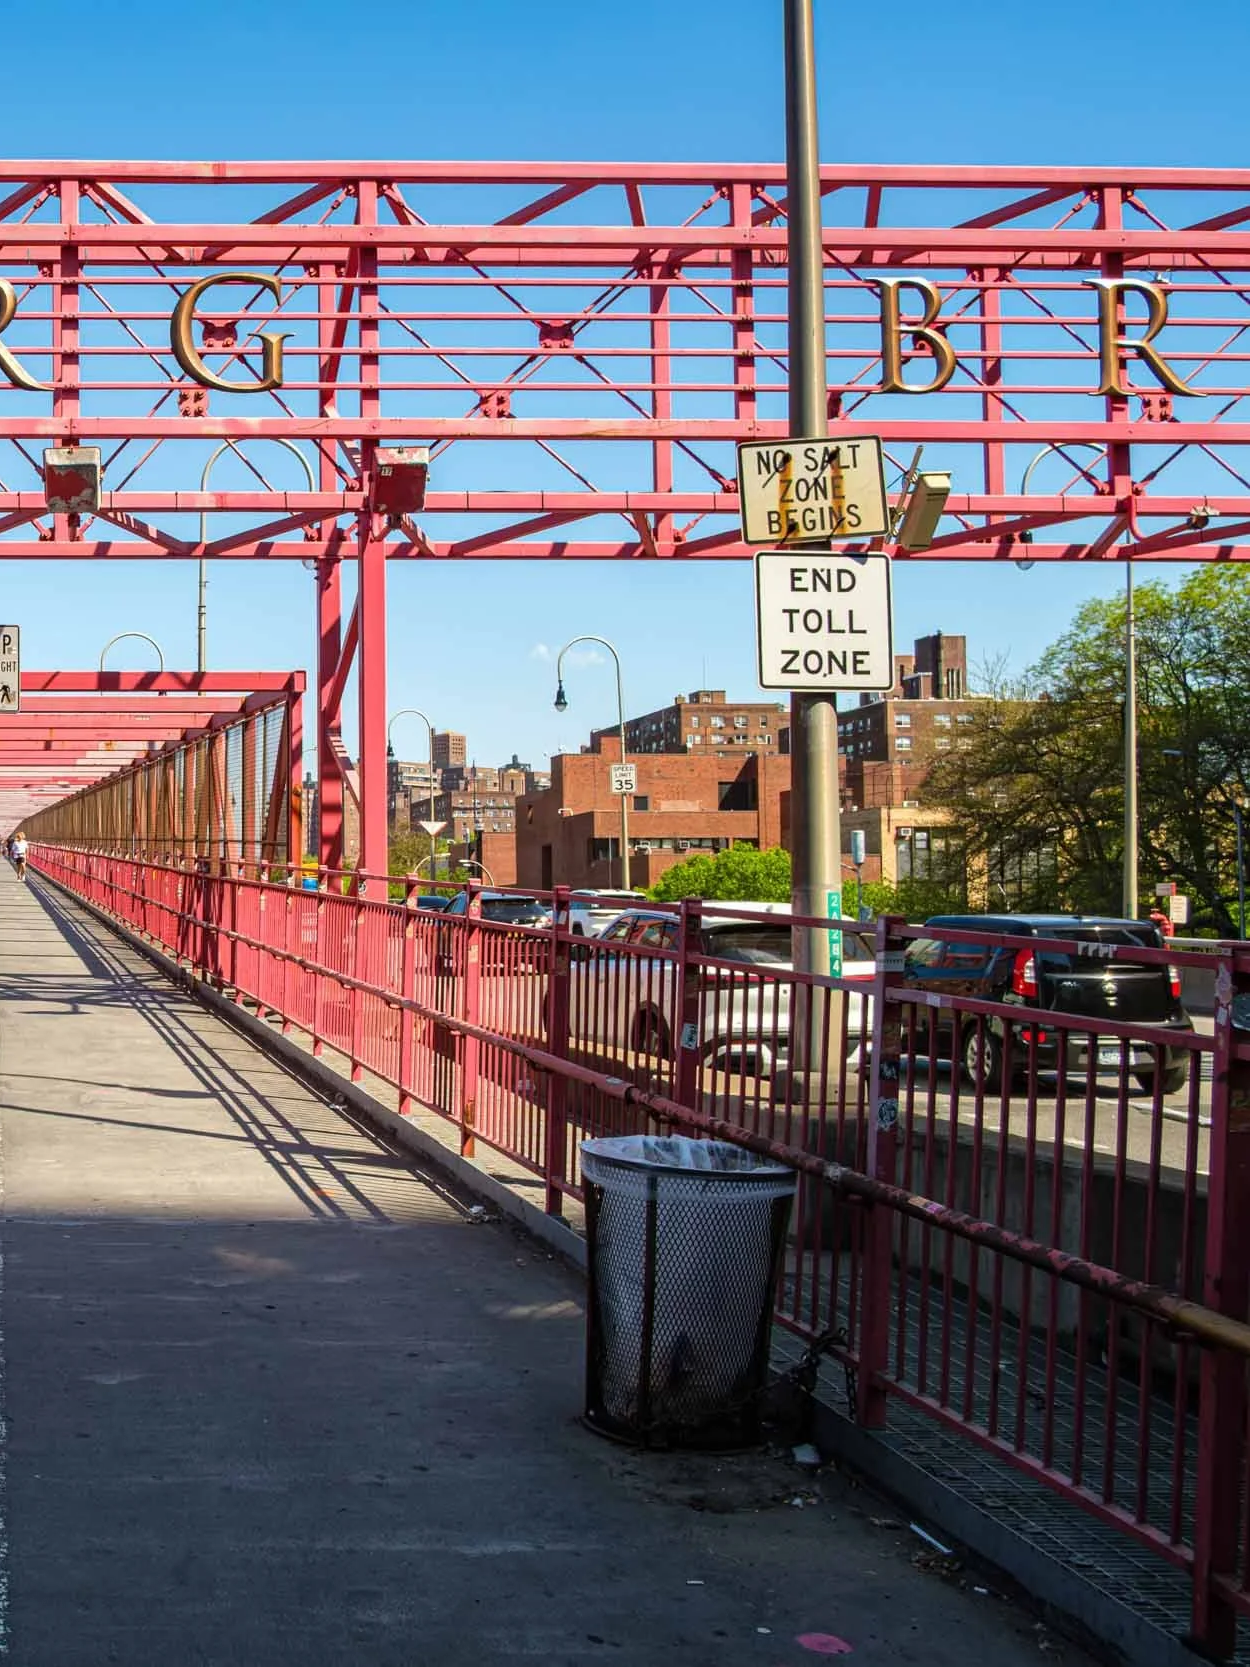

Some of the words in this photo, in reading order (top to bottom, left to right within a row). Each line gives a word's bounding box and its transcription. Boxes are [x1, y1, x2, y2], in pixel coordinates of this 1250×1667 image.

[756, 449, 791, 475] NO
[804, 444, 860, 472] SALT
[780, 475, 845, 503] ZONE
[767, 504, 862, 535] BEGINS
[790, 568, 856, 593] END
[782, 608, 867, 634] TOLL
[780, 650, 871, 675] ZONE
[615, 779, 634, 790] 35
